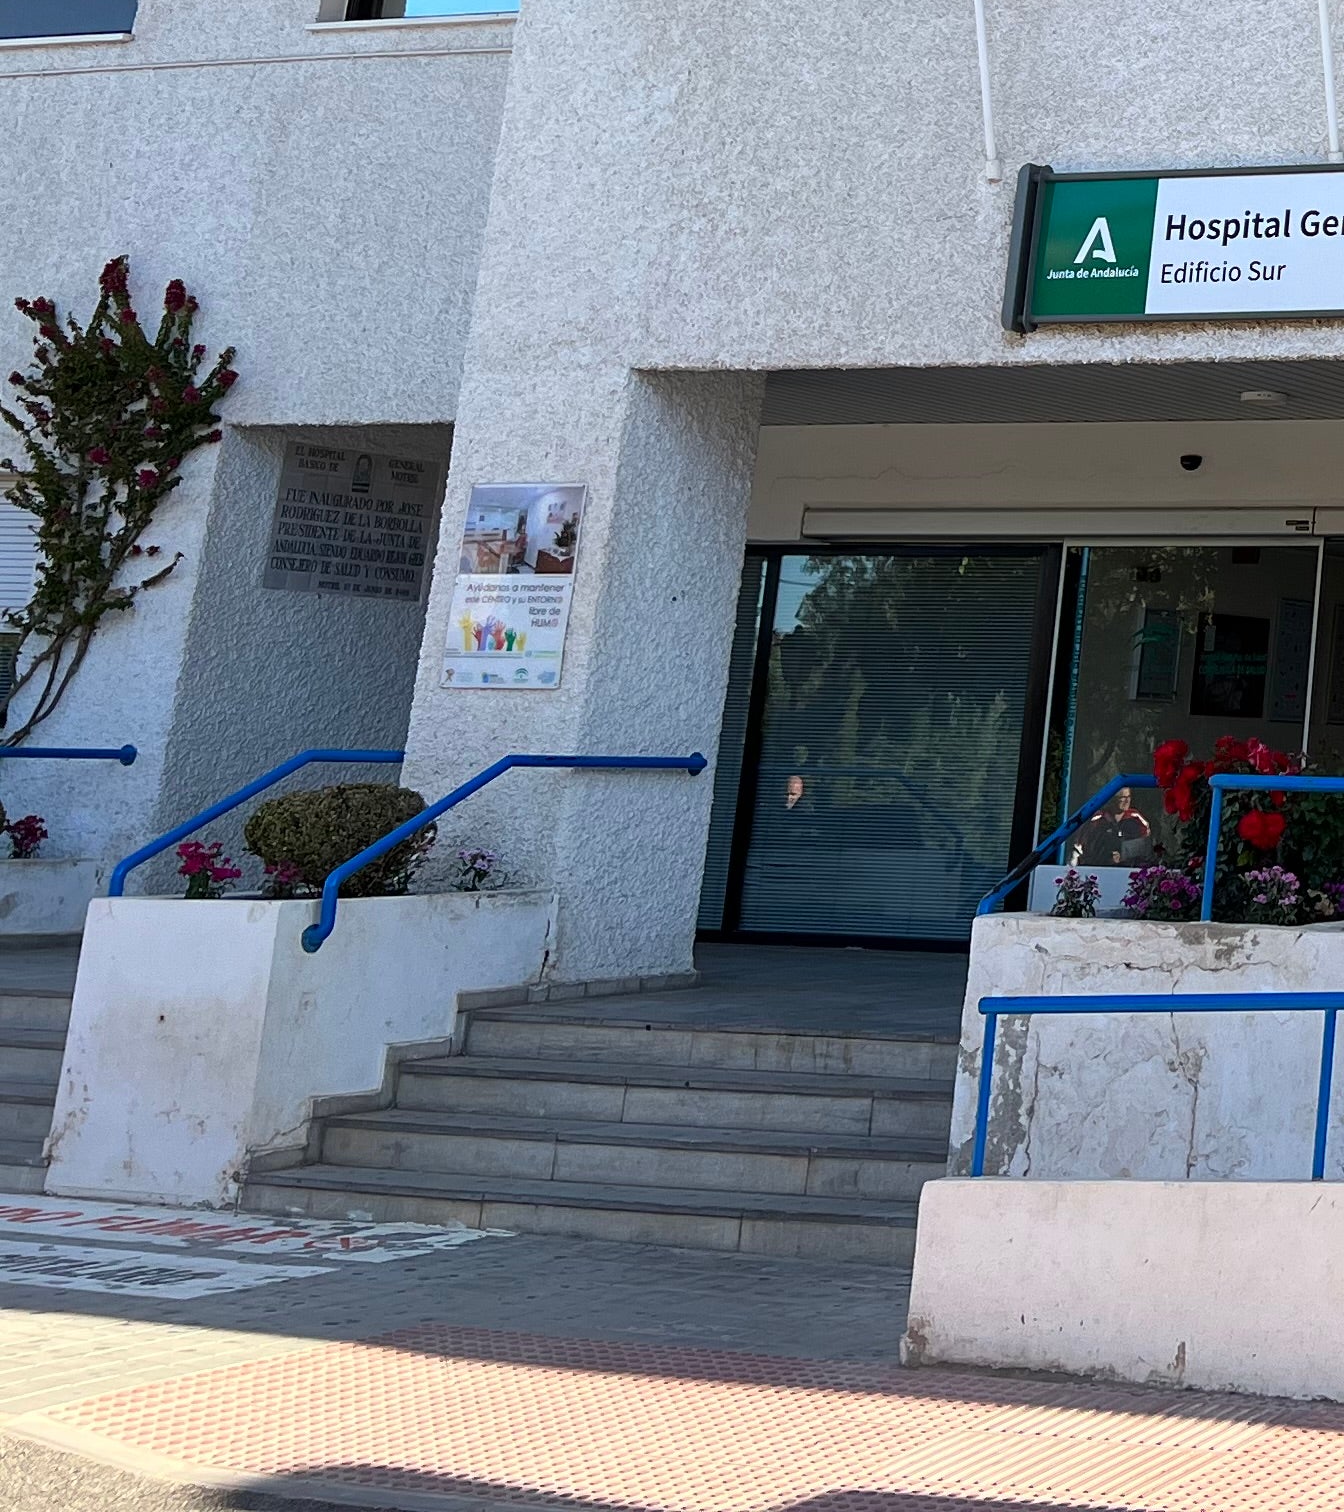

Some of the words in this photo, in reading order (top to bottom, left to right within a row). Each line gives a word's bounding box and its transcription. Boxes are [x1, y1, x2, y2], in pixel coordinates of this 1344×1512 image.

[1165, 209, 1291, 246] Hospital
[1046, 269, 1075, 280] Junta
[1076, 268, 1090, 279] de
[1090, 265, 1140, 278] Andalucía
[1160, 260, 1241, 284] Edificio
[1247, 260, 1287, 281] Sur
[286, 488, 306, 503] FUE
[309, 490, 373, 511] INAUGURADO
[374, 499, 394, 513] POR
[343, 511, 357, 526] DE
[358, 513, 371, 528] LA
[278, 522, 339, 541] PRESIDENTE
[342, 528, 355, 543] DE
[360, 531, 372, 544] LA
[321, 560, 331, 574] DE
[549, 607, 561, 615] de
